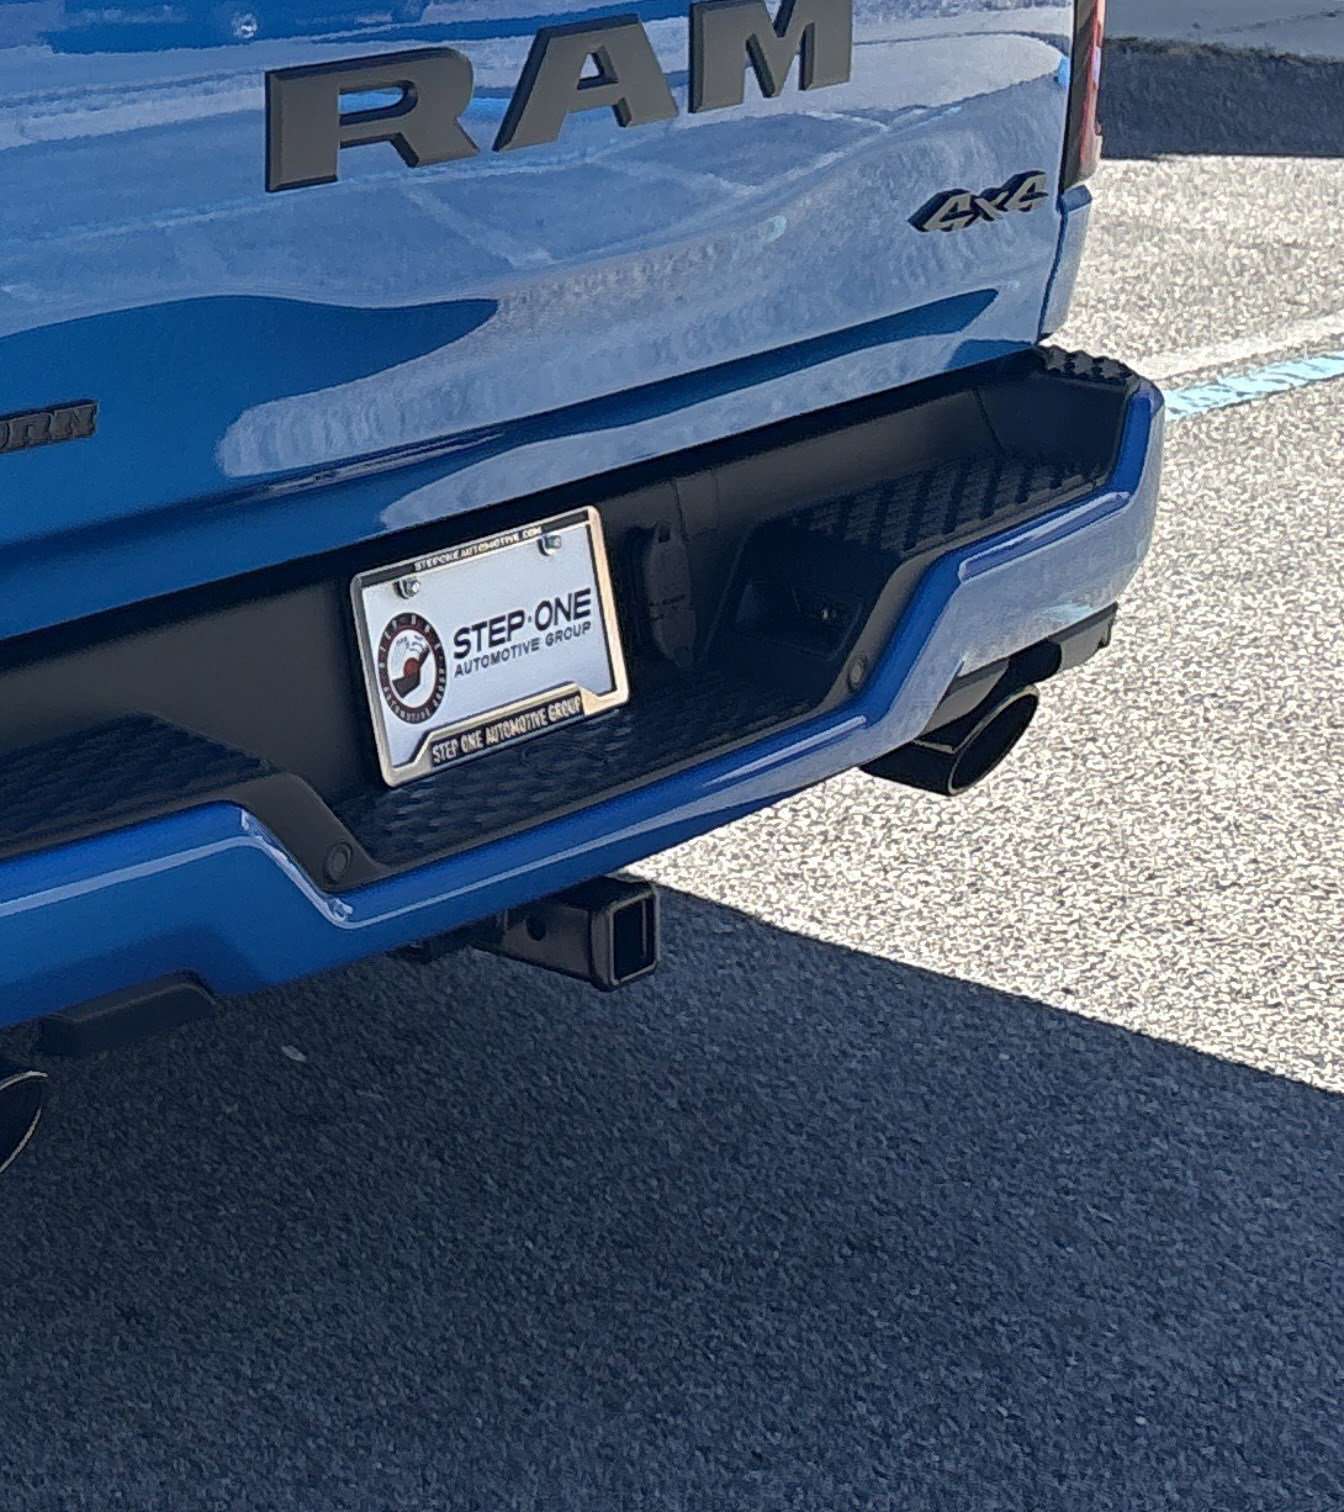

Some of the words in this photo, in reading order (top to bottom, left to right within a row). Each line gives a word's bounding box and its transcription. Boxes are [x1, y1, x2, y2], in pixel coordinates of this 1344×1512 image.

[454, 640, 540, 679] AUTOMOTIVE
[546, 620, 592, 648] GROUP
[432, 738, 459, 764] STEP
[460, 730, 484, 754] ONE
[485, 707, 548, 746] AUTOMOTIVE
